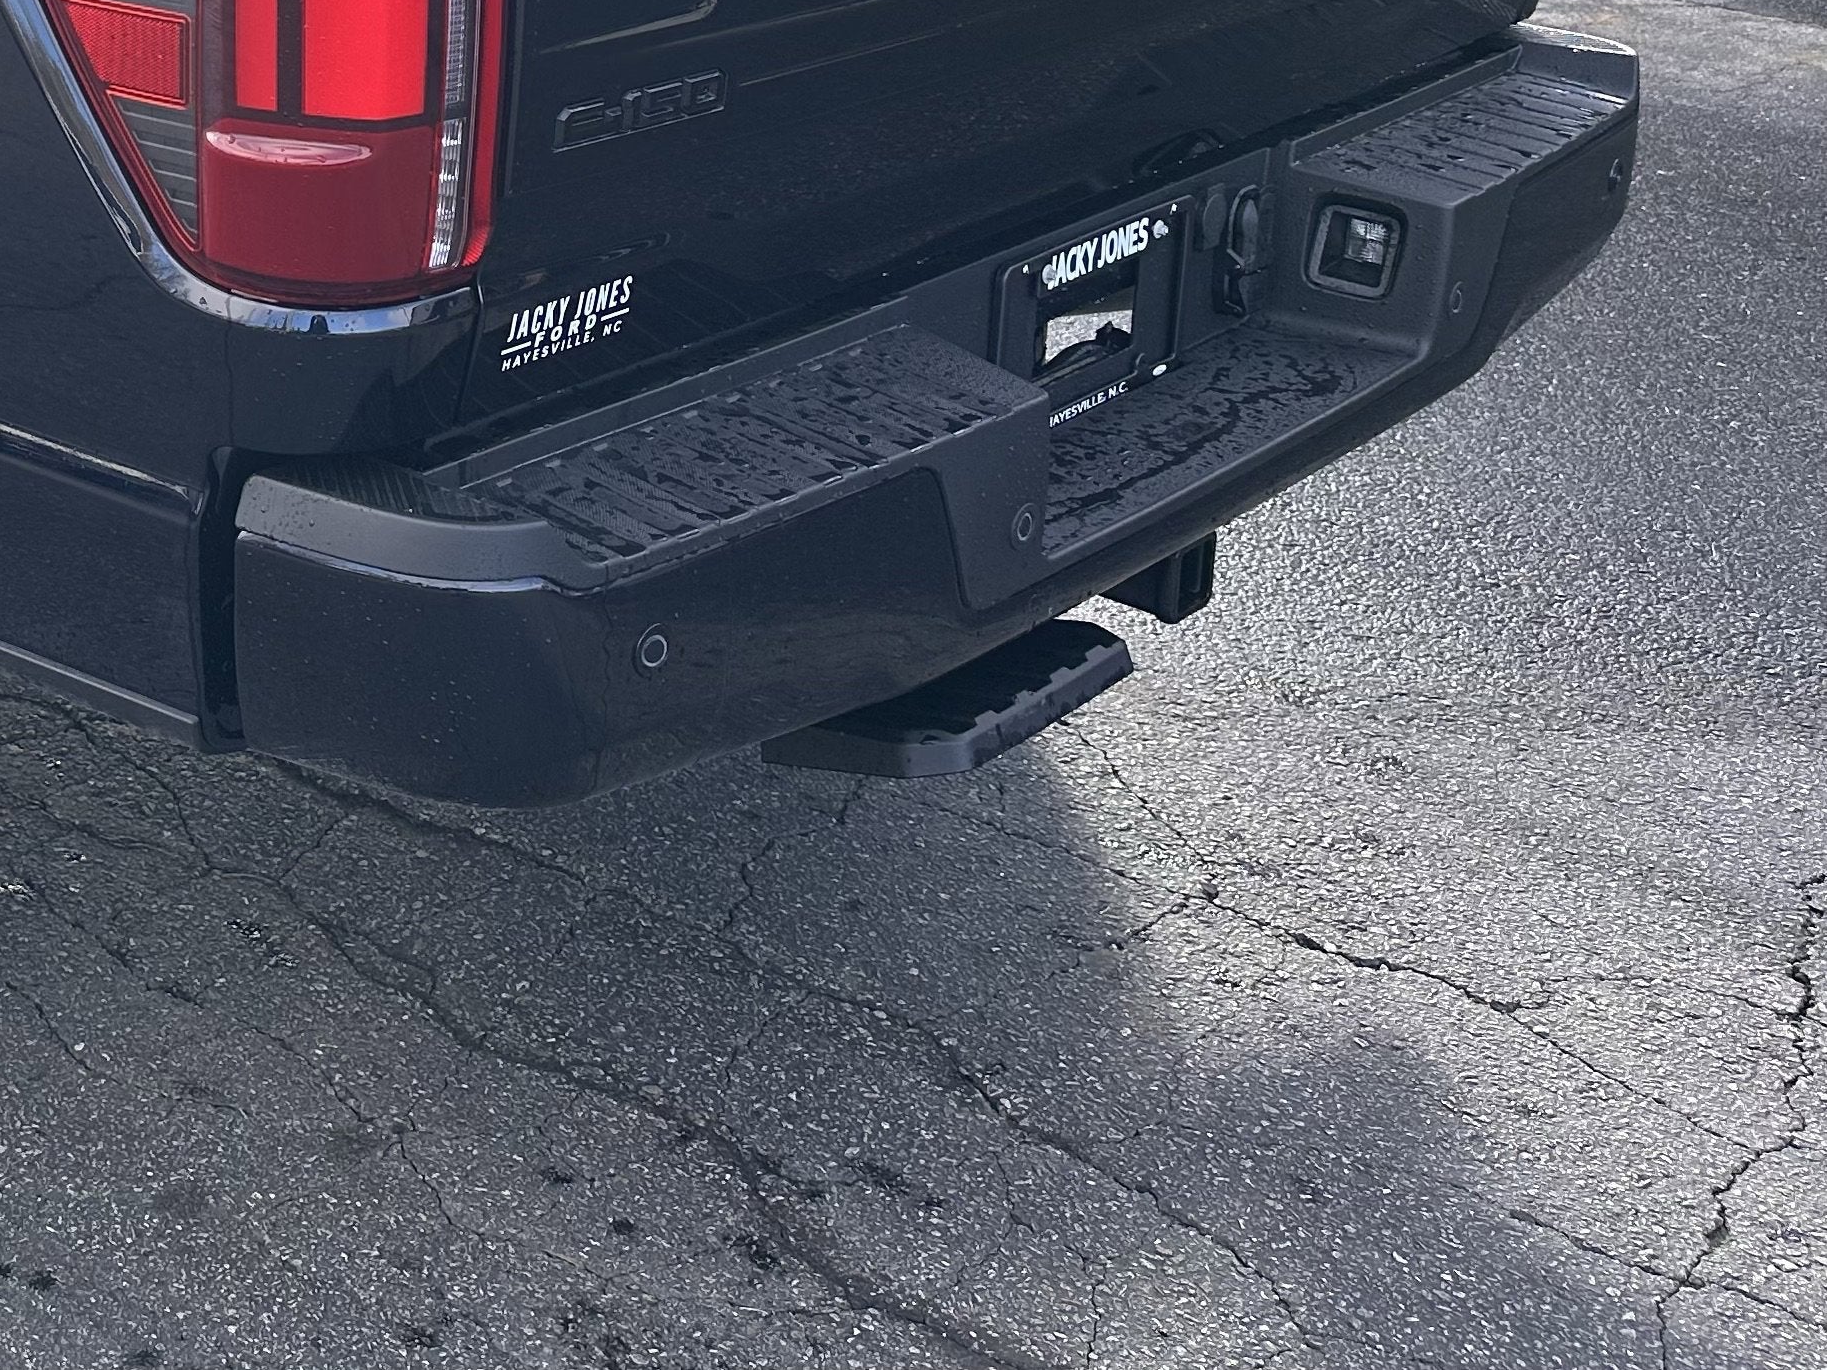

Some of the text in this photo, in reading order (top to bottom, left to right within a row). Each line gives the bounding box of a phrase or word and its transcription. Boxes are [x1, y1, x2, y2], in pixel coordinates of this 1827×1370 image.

[552, 69, 728, 153] F-150
[1097, 217, 1149, 269] JONES
[506, 275, 633, 343] JACKY JONES
[533, 313, 597, 348] FORD
[501, 320, 623, 372] HAYESVILLE, NC
